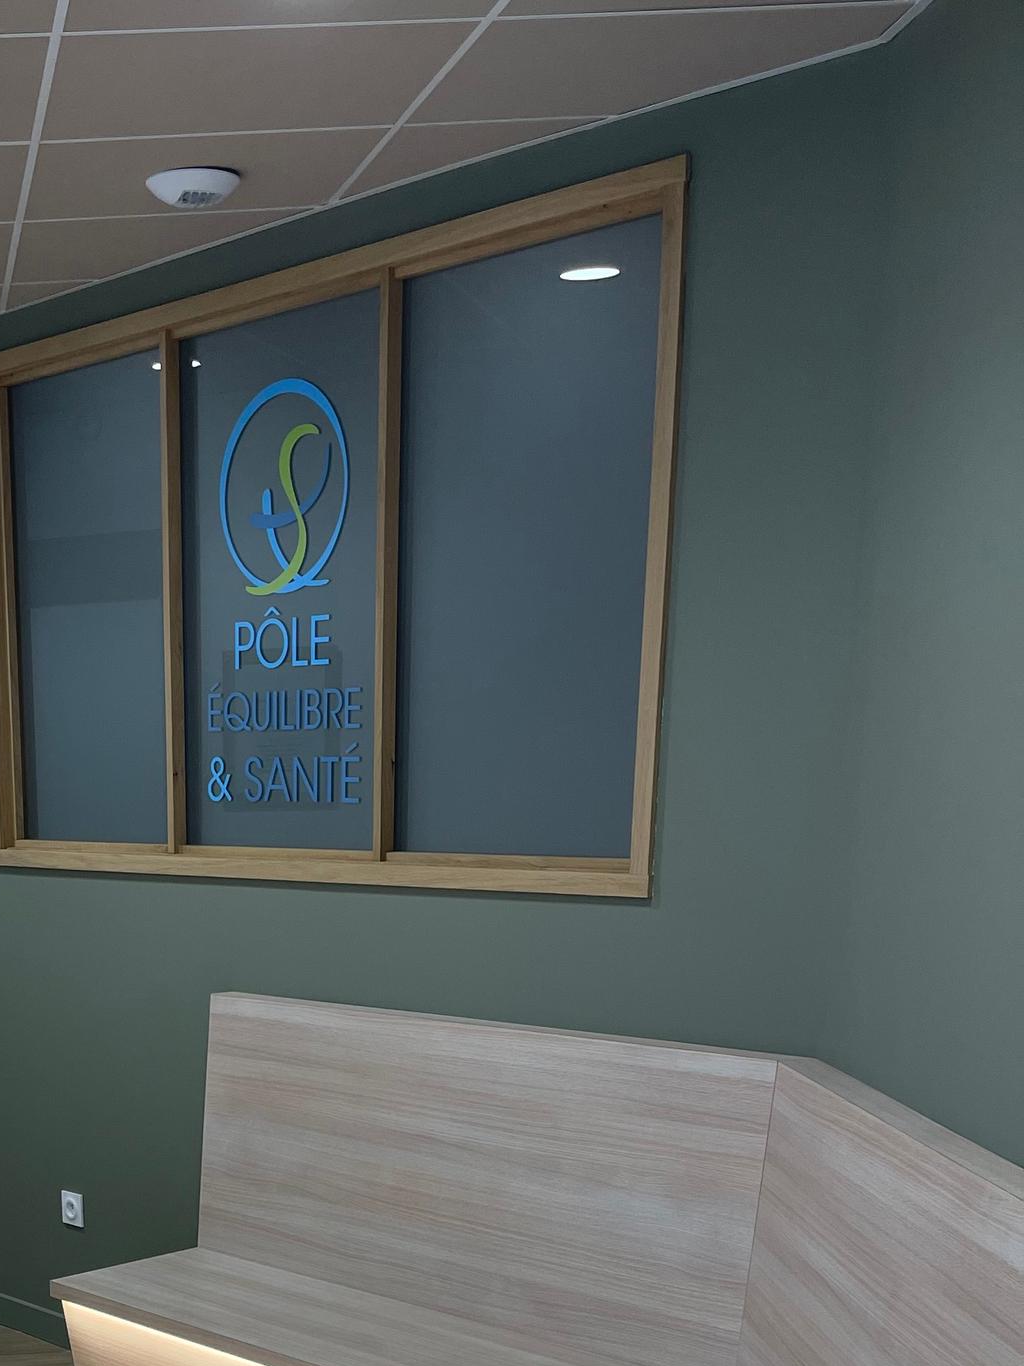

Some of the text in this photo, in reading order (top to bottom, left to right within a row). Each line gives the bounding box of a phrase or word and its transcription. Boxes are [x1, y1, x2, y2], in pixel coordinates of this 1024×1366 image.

[234, 606, 332, 670] PÔLE
[207, 682, 363, 733] ÉQUILIBRE
[207, 742, 362, 804] & SANTÉ
